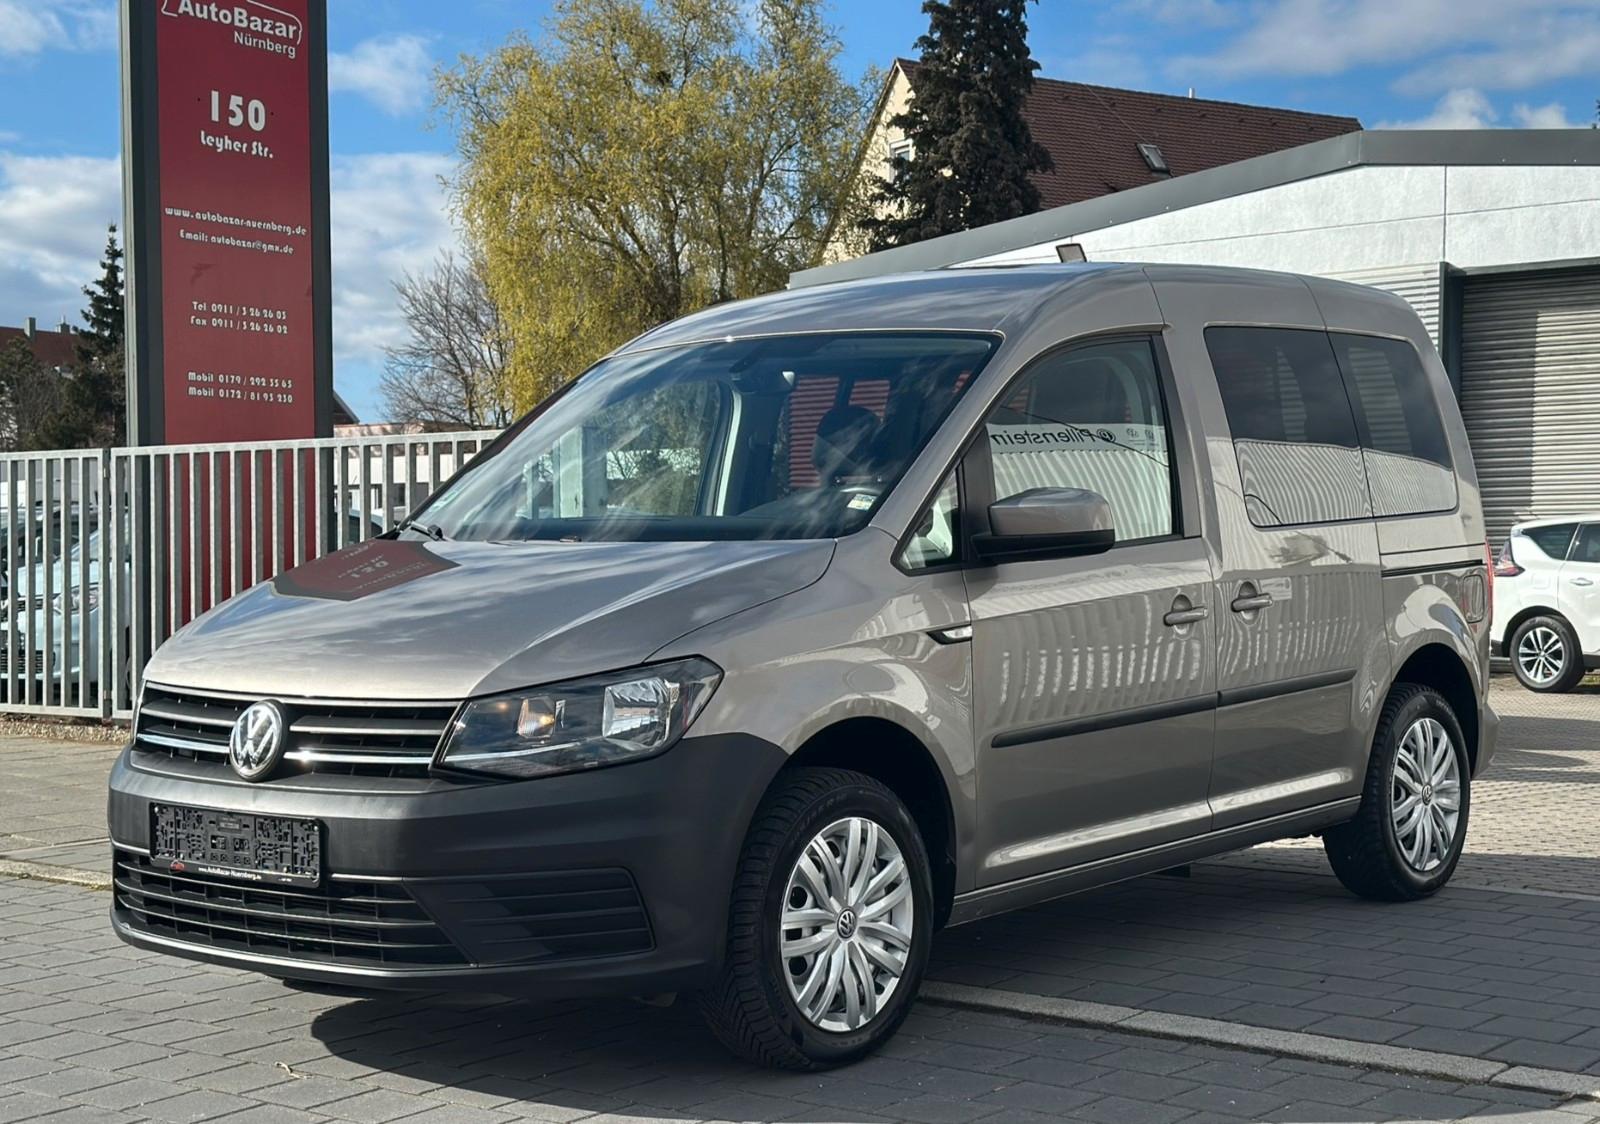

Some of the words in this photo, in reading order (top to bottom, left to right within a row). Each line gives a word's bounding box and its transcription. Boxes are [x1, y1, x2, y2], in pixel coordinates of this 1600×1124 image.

[178, 0, 297, 39] AutoBazar
[233, 31, 296, 59] Nürnberg
[210, 90, 266, 132] 150
[251, 141, 274, 159] Str.
[192, 301, 207, 312] Tel
[190, 315, 207, 326] Fax
[188, 372, 214, 382] Mobil
[188, 386, 214, 397] Mobil
